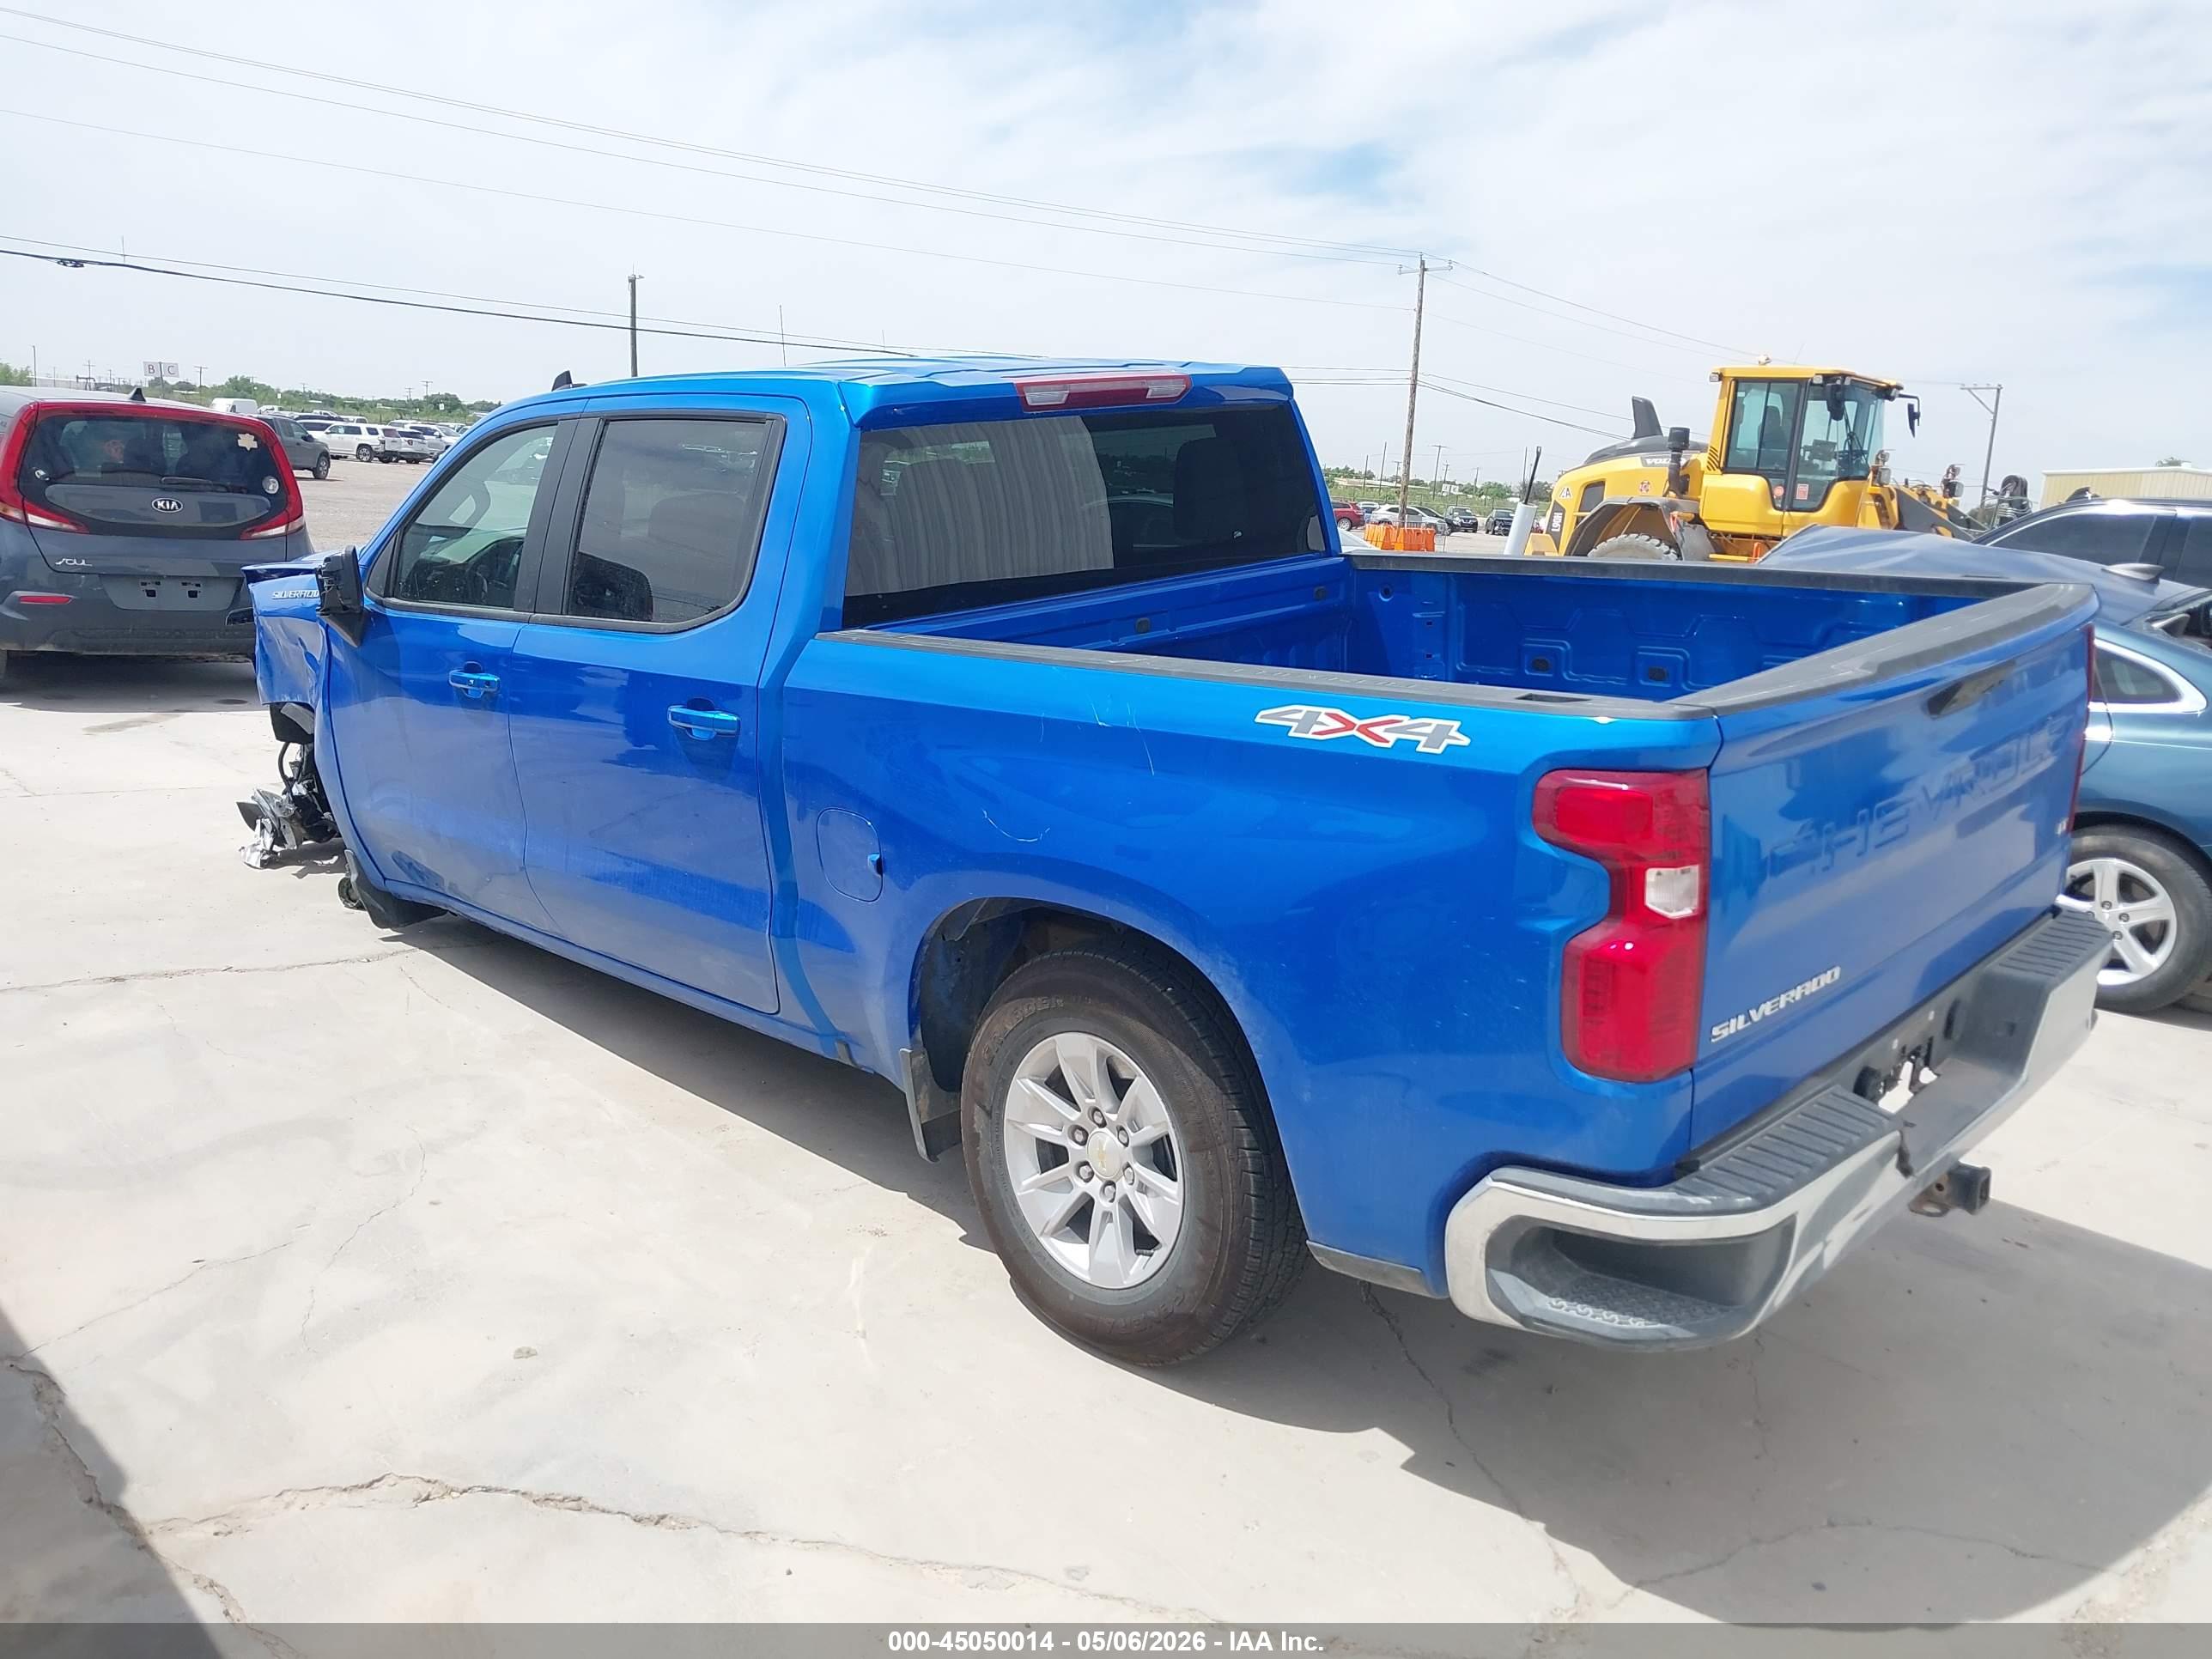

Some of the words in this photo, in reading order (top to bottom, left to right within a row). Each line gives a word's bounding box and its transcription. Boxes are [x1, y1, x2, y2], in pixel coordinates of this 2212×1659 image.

[148, 364, 155, 374] B
[167, 365, 175, 374] C
[156, 500, 179, 511] KIA
[1710, 965, 1841, 1043] SILVERADO
